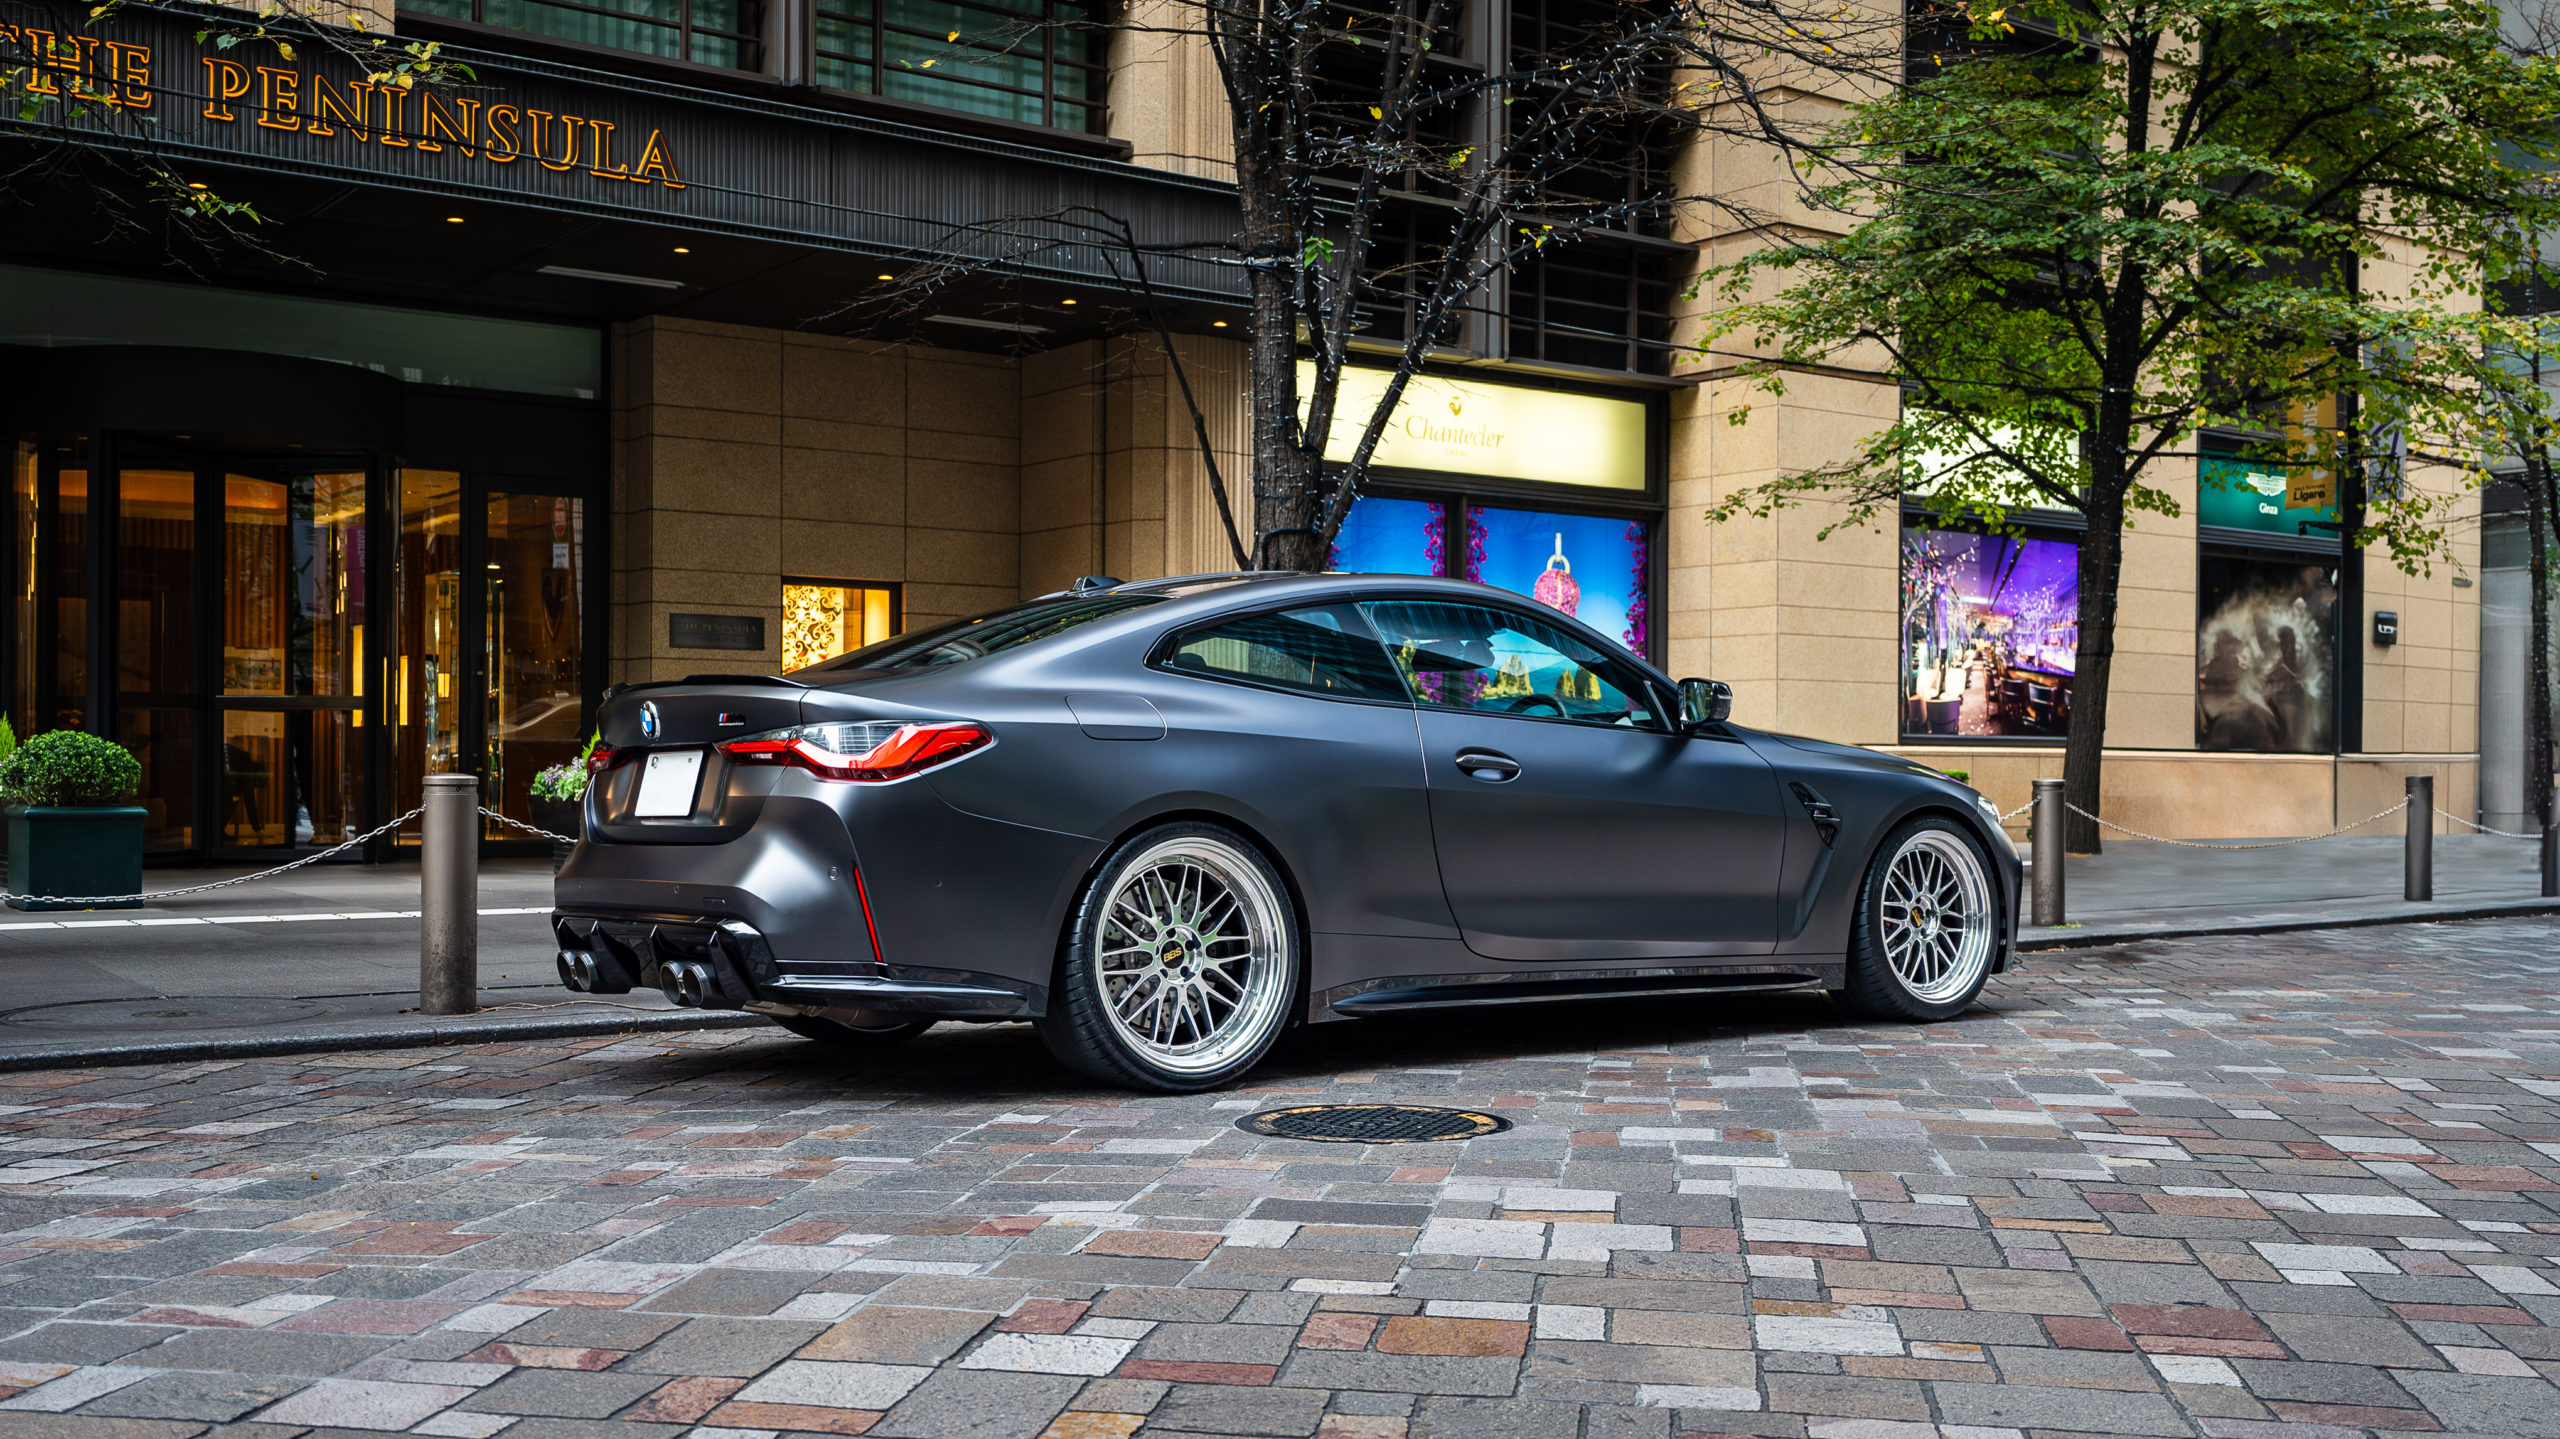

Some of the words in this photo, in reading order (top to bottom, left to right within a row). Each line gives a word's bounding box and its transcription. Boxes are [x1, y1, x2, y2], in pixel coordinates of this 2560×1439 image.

[202, 56, 686, 189] PENINSULA
[1405, 414, 1505, 449] Chantecler
[1163, 946, 1183, 963] BBS
